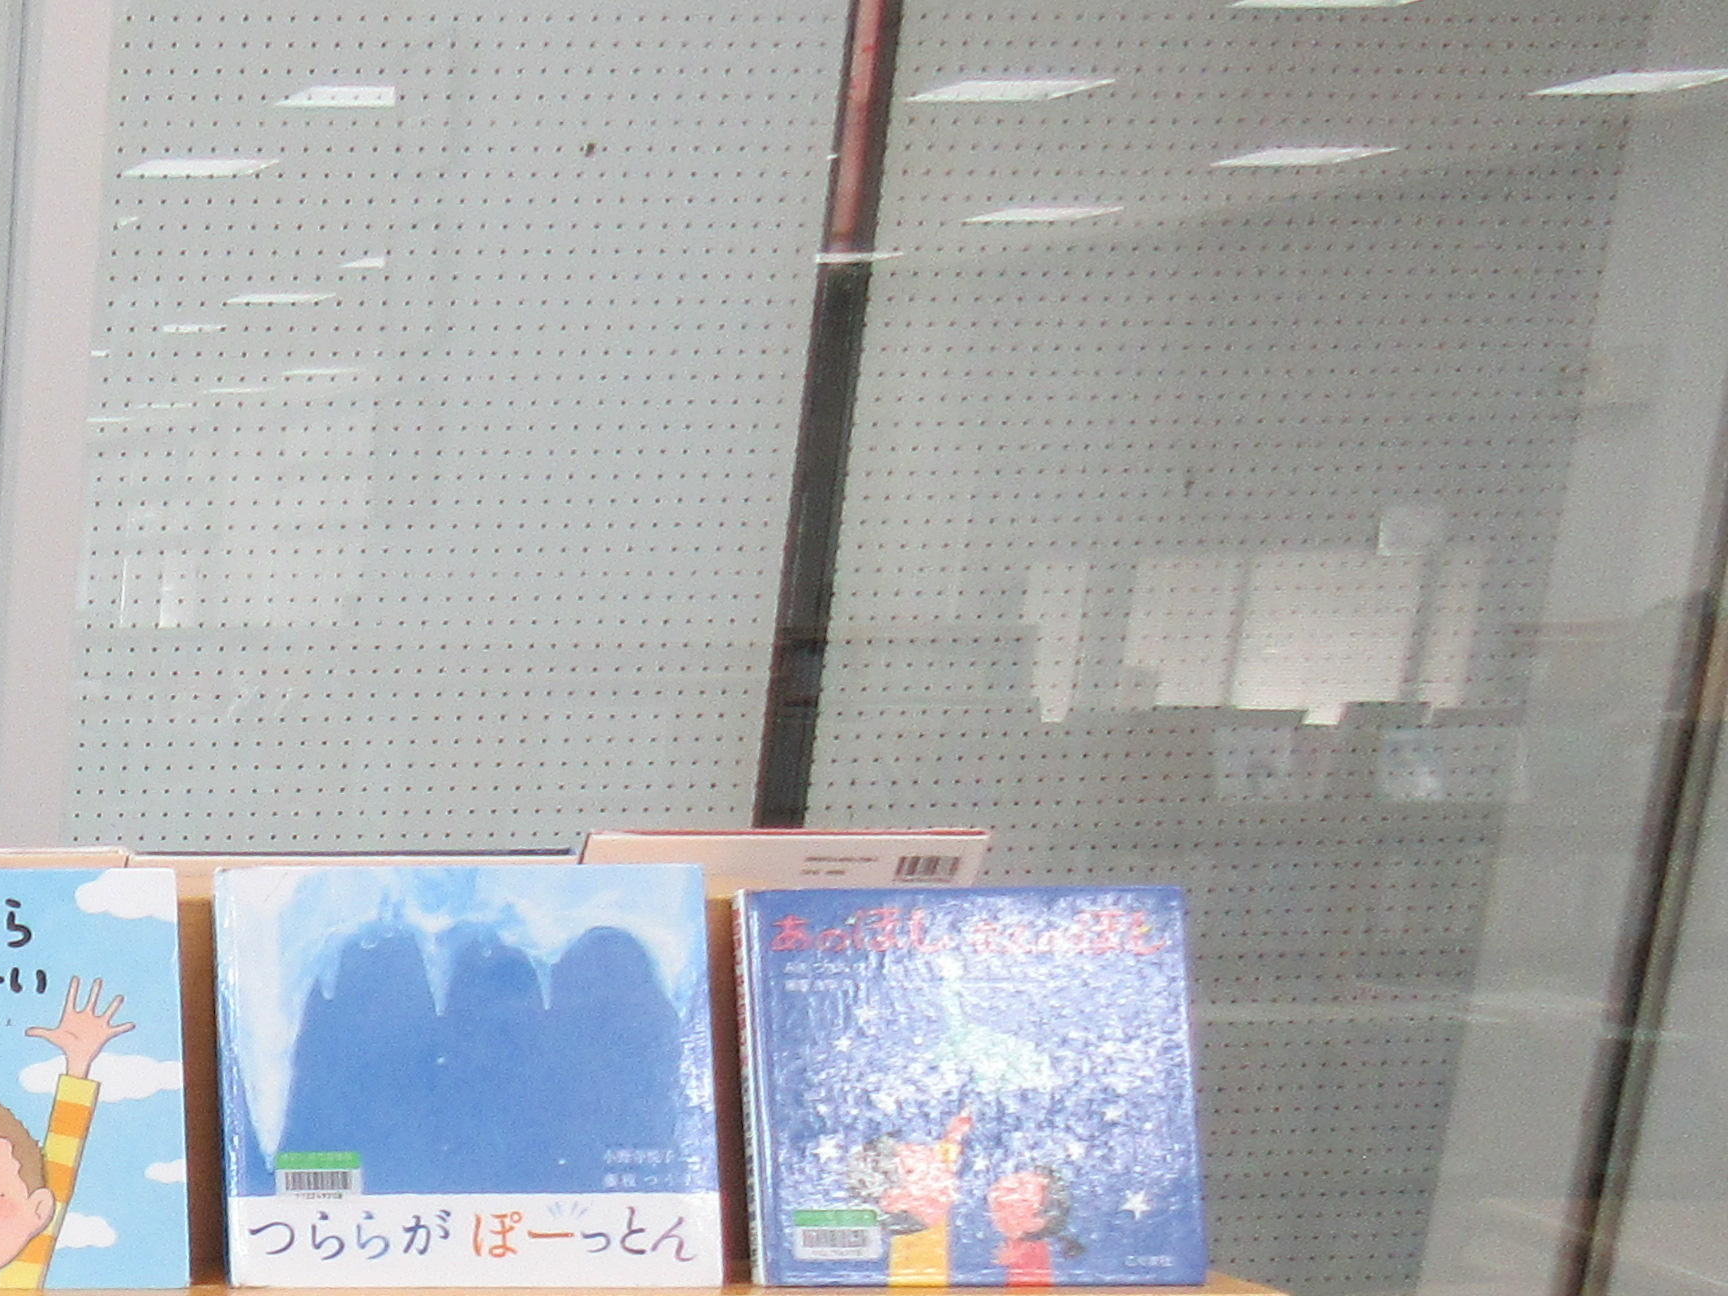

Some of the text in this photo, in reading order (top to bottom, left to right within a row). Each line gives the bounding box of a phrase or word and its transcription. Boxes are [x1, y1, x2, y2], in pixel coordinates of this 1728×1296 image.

[248, 1206, 696, 1262] つららが ぽーっとん
